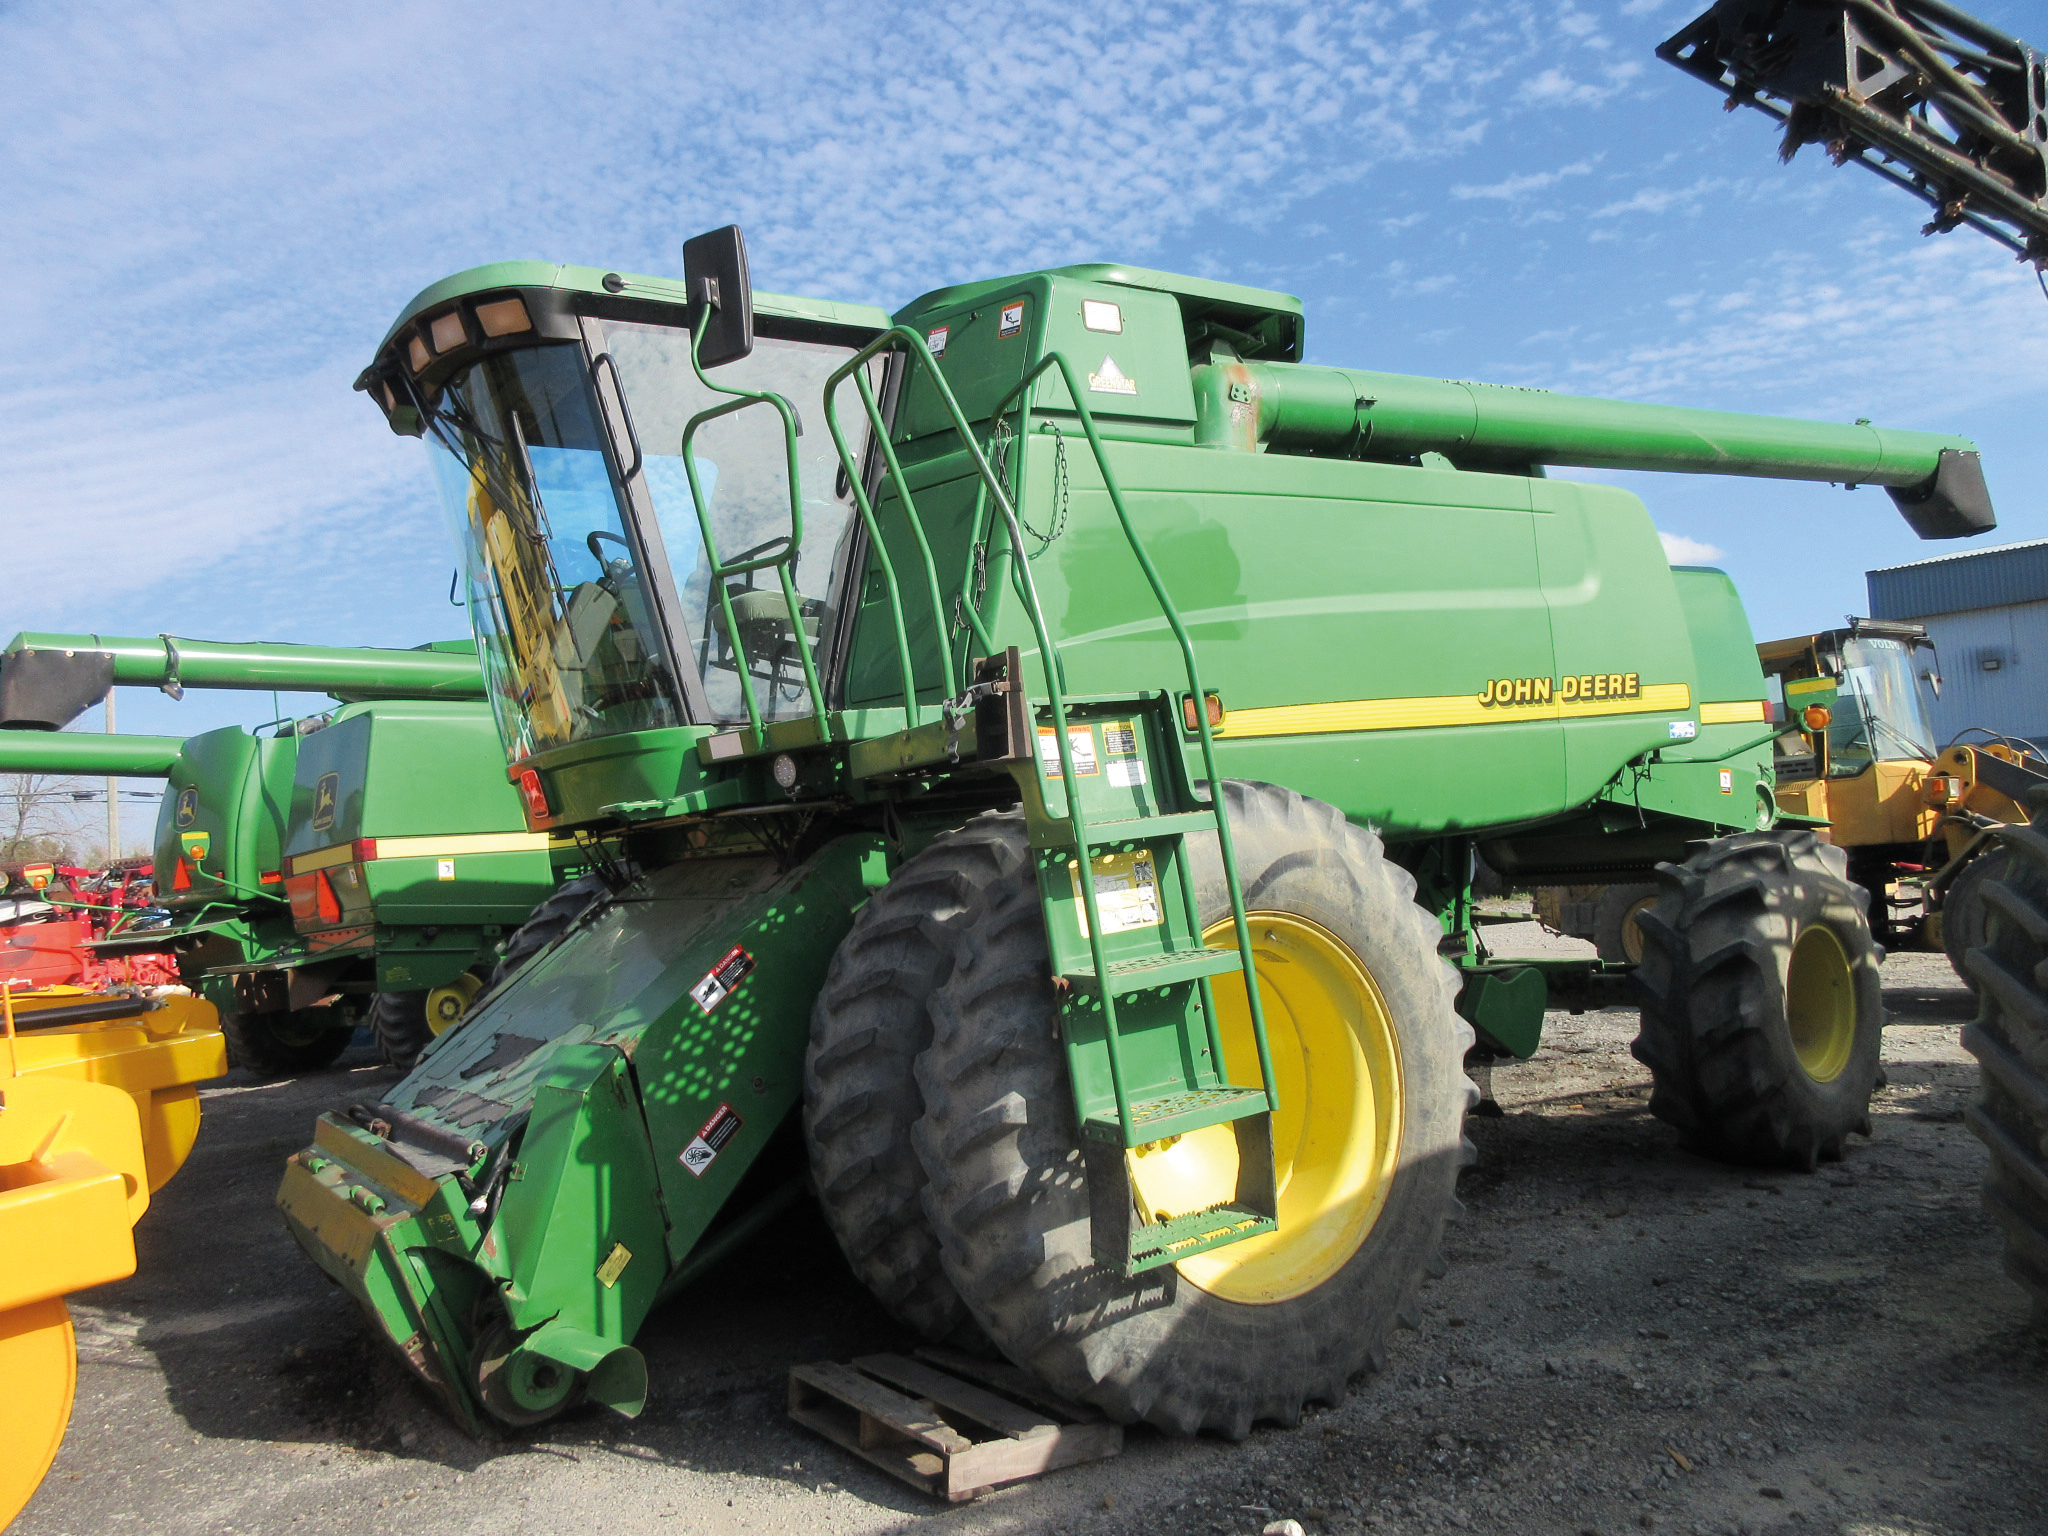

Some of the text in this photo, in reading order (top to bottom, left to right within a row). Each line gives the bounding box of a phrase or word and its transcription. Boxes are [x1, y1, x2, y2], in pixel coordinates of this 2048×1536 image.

[1868, 639, 1901, 650] VOLVO
[1478, 672, 1640, 707] JOHN DEERE
[719, 948, 740, 969] DANGER
[705, 1105, 728, 1132] DANGER
